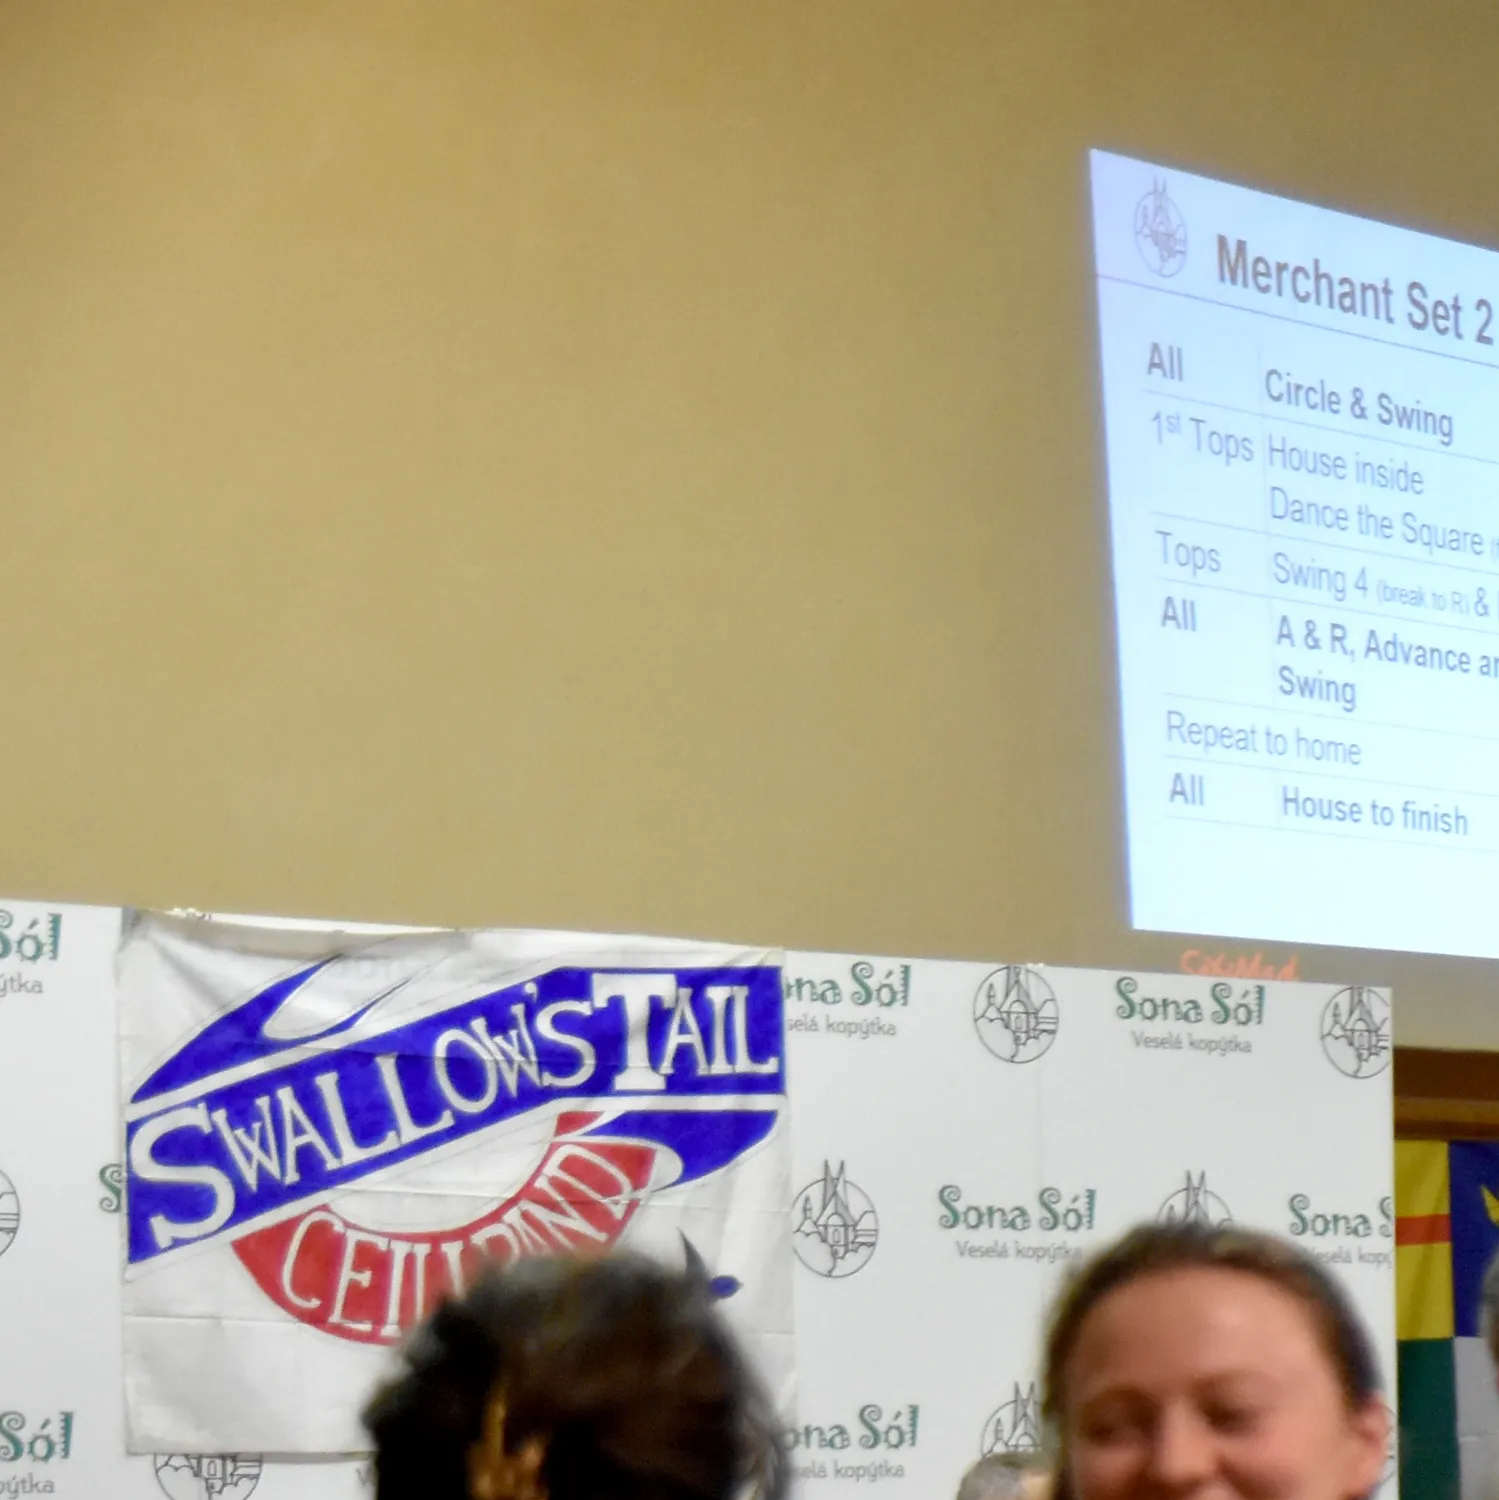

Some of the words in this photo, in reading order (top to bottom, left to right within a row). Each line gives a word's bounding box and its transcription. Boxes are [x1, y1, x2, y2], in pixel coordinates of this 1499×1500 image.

[1216, 233, 1395, 325] Merchant
[1406, 280, 1464, 341] Set
[1474, 297, 1494, 346] 2
[1146, 341, 1184, 382] All
[1264, 368, 1342, 416] Circle
[1349, 386, 1368, 420] &
[1376, 392, 1454, 447] Swing
[1189, 416, 1255, 467] Tops
[1268, 433, 1348, 481] House
[1355, 451, 1424, 495] inside
[1269, 485, 1350, 532] Dance
[1356, 503, 1394, 540] the
[1401, 511, 1484, 556] Square
[1154, 528, 1222, 577] Tops
[1272, 551, 1347, 602] Swing
[1353, 565, 1369, 598] 4
[1430, 591, 1448, 613] to
[1473, 585, 1490, 618] &
[1160, 595, 1198, 632] All
[1275, 614, 1296, 648] A
[1302, 618, 1323, 651] &
[1330, 622, 1356, 663] R,
[1363, 628, 1472, 675] Advance
[1278, 663, 1358, 713] Swing
[1165, 709, 1260, 755] Repeat
[1264, 723, 1289, 756] to
[1295, 726, 1363, 766] home
[1169, 771, 1206, 807] All
[1281, 784, 1364, 824] House
[1370, 798, 1395, 827] to
[1401, 800, 1470, 836] finish
[849, 960, 912, 1008] Sól
[1115, 975, 1204, 1024] Sona
[1210, 981, 1266, 1026] Sól
[591, 973, 781, 1092] TAIL
[937, 1183, 1032, 1232] Sona
[1038, 1186, 1097, 1232] Sól
[1287, 1192, 1372, 1238] Sona
[858, 1403, 920, 1451] Sól
